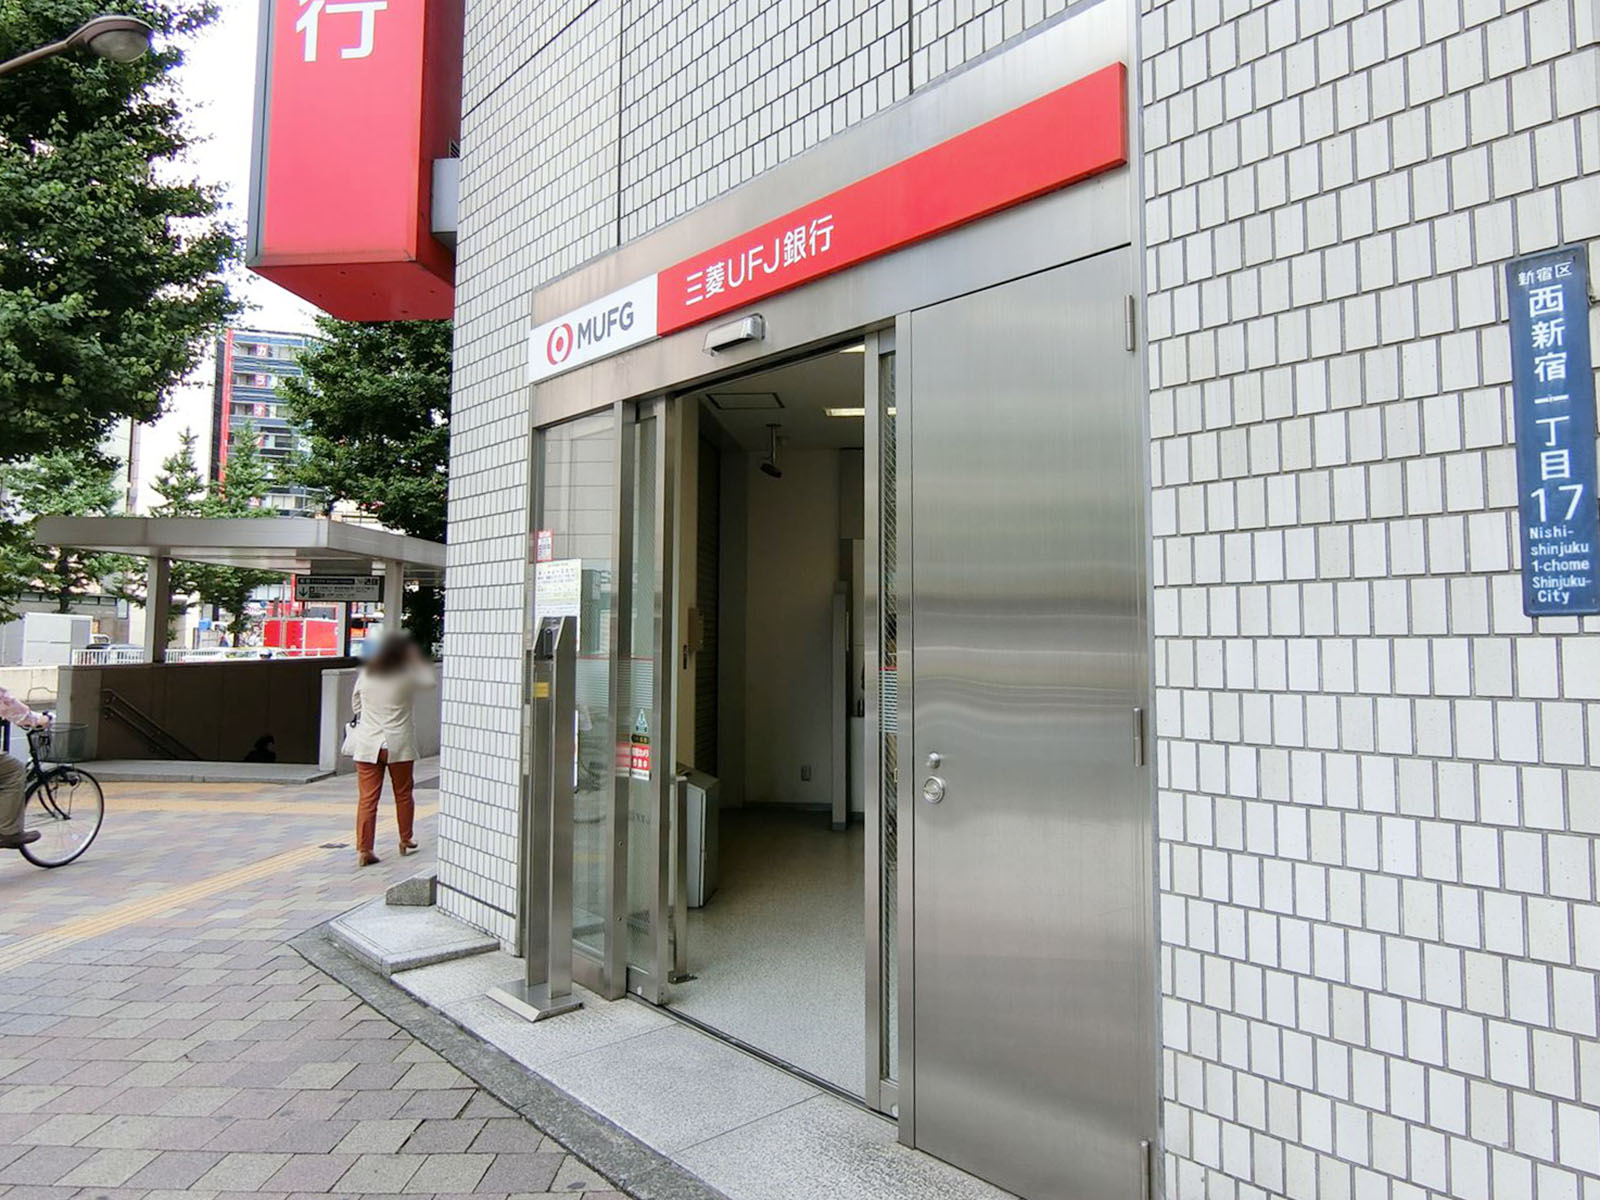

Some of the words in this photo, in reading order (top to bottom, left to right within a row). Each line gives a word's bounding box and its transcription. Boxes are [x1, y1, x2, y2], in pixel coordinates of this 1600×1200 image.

[296, 0, 387, 62] 行
[685, 214, 835, 307] 三菱UFJ銀行
[1518, 262, 1573, 285] 新宿区
[577, 301, 635, 350] MUFG
[1529, 284, 1571, 481] 西新宿一丁目
[1530, 484, 1584, 523] 17
[1529, 525, 1574, 540] Nishi-
[1530, 541, 1590, 557] shinjuku
[1531, 559, 1590, 573] 1-chome
[1532, 574, 1592, 590] Shinjuku-
[1537, 590, 1571, 605] City
